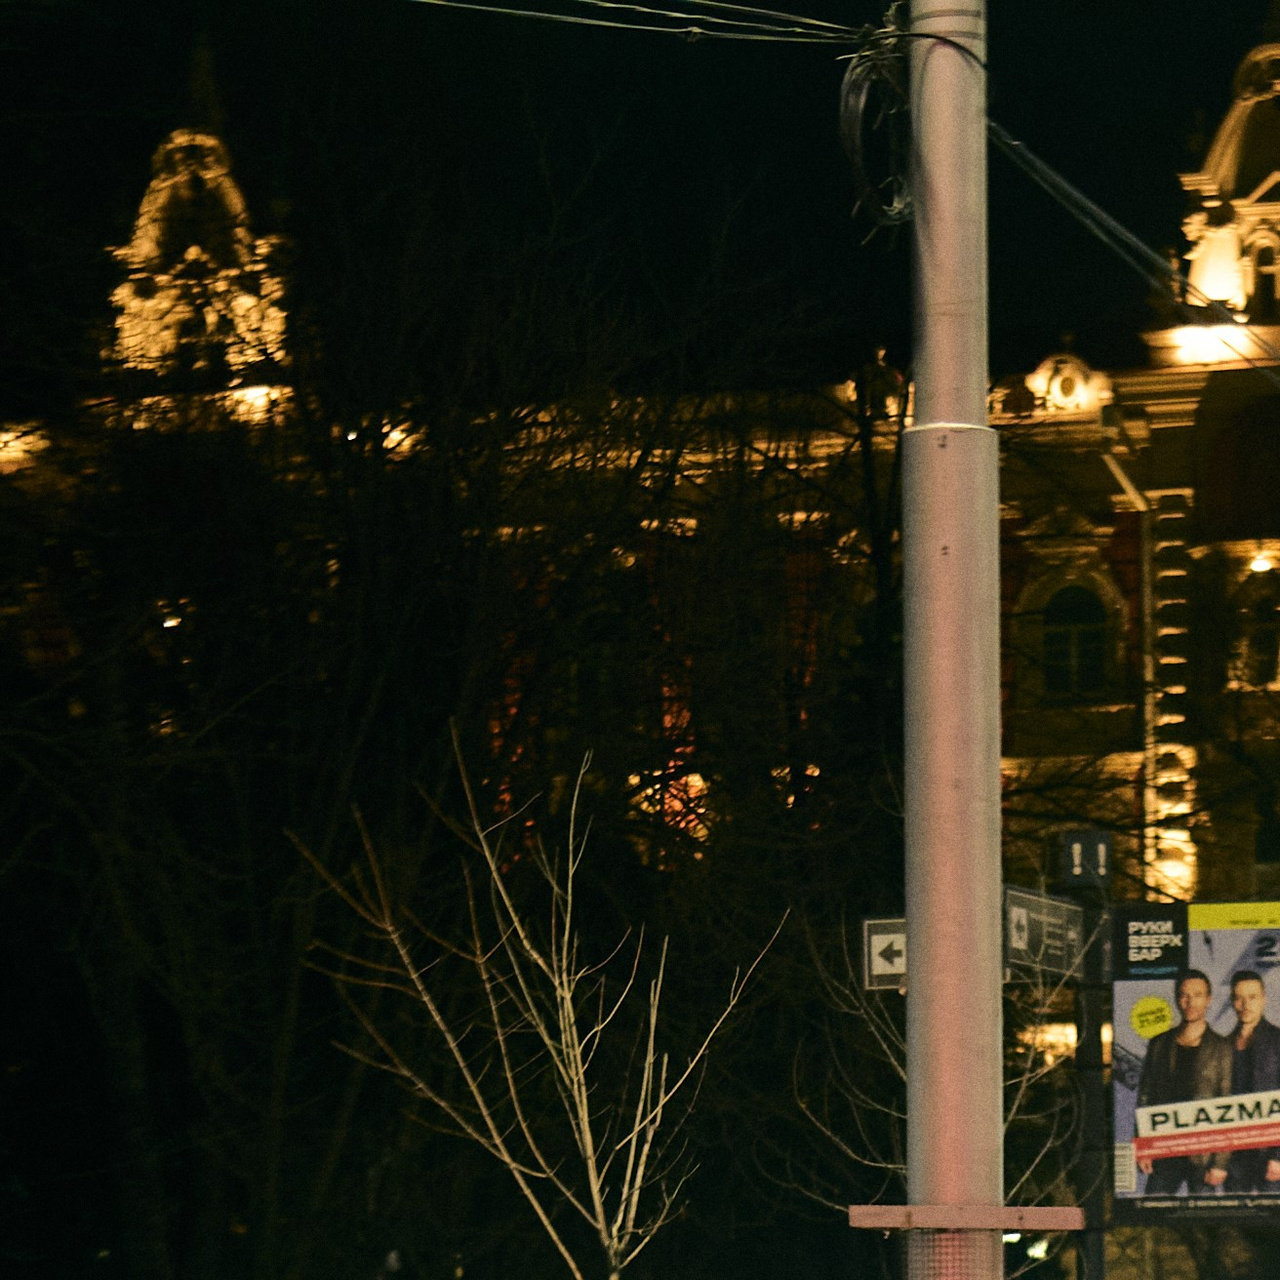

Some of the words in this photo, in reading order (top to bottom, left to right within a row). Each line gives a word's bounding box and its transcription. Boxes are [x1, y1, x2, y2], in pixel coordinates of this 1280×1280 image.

[1128, 921, 1173, 934] РУКИ
[1128, 934, 1183, 948] ВВЕРХ
[1128, 948, 1163, 962] БАР
